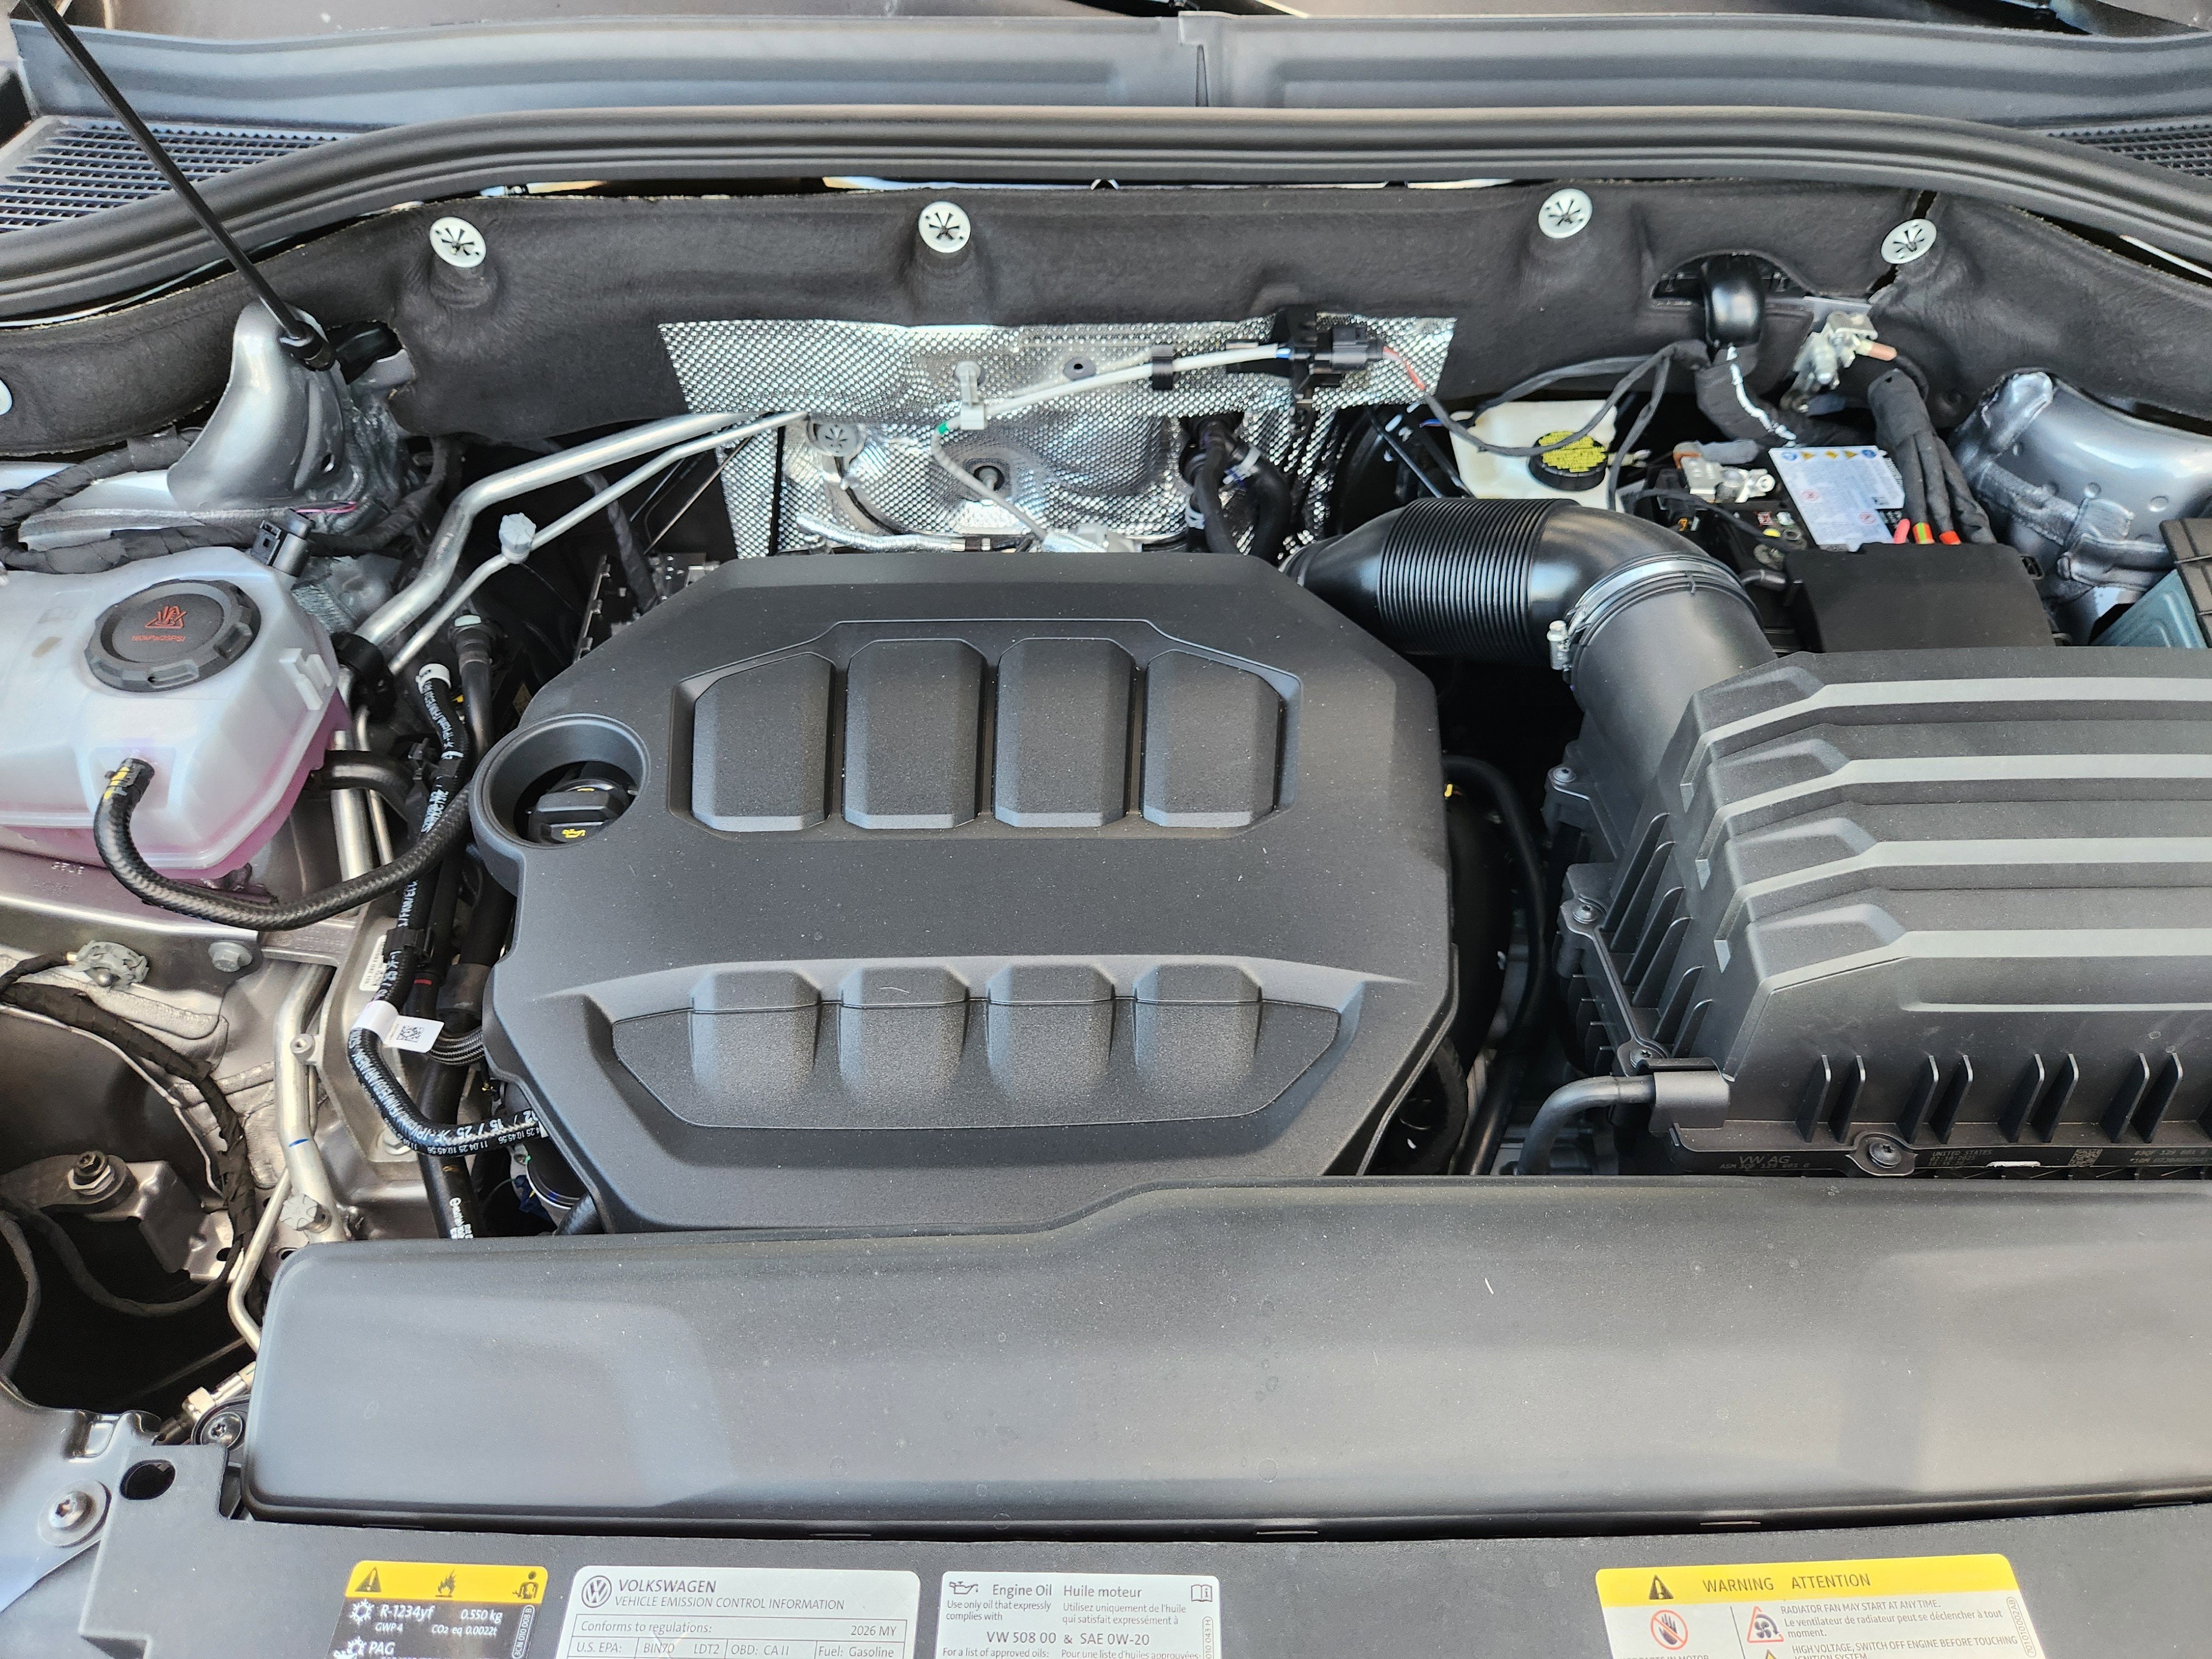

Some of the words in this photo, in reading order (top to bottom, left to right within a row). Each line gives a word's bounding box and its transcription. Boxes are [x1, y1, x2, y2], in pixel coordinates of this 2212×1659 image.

[1769, 1155, 1791, 1164] AG
[619, 1579, 717, 1593] VOLKSWAGEN
[1703, 1577, 1774, 1593] WARNING
[1792, 1573, 1871, 1589] ATTENTION
[993, 1584, 1032, 1599] Engine
[1036, 1584, 1052, 1596] Oil
[1064, 1585, 1094, 1597] Huile
[1098, 1587, 1142, 1598] moteur
[615, 1596, 658, 1606] VEHICLE
[661, 1597, 713, 1608] EMISSION
[716, 1597, 766, 1609] CONTROL
[769, 1599, 845, 1610] INFORMATION
[947, 1600, 962, 1609] Use
[964, 1600, 982, 1611] only
[983, 1600, 993, 1609] oil
[995, 1600, 1012, 1609] that
[1014, 1601, 1052, 1612] expressly
[1063, 1603, 1094, 1612] Utilisez
[1096, 1603, 1147, 1615] uniquement
[1149, 1604, 1159, 1613] de
[1161, 1604, 1186, 1613] l'huile
[1781, 1604, 1823, 1614] RADIATOR
[1825, 1603, 1841, 1612] FAN
[1842, 1603, 1860, 1611] MAY
[1862, 1601, 1886, 1610] START
[1900, 1600, 1916, 1609] ANY
[1917, 1599, 1941, 1609] TIME.
[380, 1604, 435, 1623] R-1234yf
[461, 1609, 488, 1621] 0.550
[489, 1609, 503, 1625] kg
[946, 1611, 982, 1622] complies
[984, 1612, 1003, 1621] with
[1062, 1615, 1076, 1625] qui
[1078, 1615, 1111, 1624] satisfait
[1113, 1615, 1172, 1626] expressément
[1173, 1615, 1179, 1625] à
[1784, 1618, 1795, 1627] Le
[1797, 1616, 1843, 1626] ventilateur
[1845, 1615, 1855, 1625] de
[1856, 1614, 1895, 1624] radiateur
[1897, 1614, 1917, 1624] peut
[1929, 1611, 1975, 1621] déclencher
[1977, 1609, 1983, 1619] à
[1984, 1610, 2003, 1618] tout
[375, 1622, 397, 1632] GWP
[397, 1623, 403, 1632] 4
[452, 1626, 462, 1637] eq
[465, 1625, 498, 1636] 0.0022t
[581, 1620, 632, 1632] Conforms
[635, 1621, 646, 1632] to
[649, 1621, 712, 1635] regulations:
[851, 1625, 876, 1636] 2026
[879, 1626, 897, 1636] MY
[1788, 1629, 1827, 1638] moment.
[514, 1641, 524, 1656] 3CN
[519, 1628, 527, 1640] 010
[523, 1614, 531, 1627] 008
[987, 1631, 1009, 1642] VW
[1013, 1632, 1036, 1644] 508
[1040, 1632, 1057, 1644] 00
[1063, 1634, 1073, 1644] &
[1080, 1633, 1103, 1645] SAE
[1107, 1634, 1150, 1646] 0W-20
[369, 1641, 396, 1656] PAG
[576, 1642, 595, 1652] U.S.
[598, 1642, 622, 1653] EPA:
[643, 1643, 675, 1653] BIN70
[693, 1644, 719, 1654] LDT2
[731, 1644, 758, 1655] OBD:
[764, 1645, 780, 1656] CA
[818, 1646, 843, 1657] Fuel:
[848, 1646, 894, 1658] Gasoline
[1792, 1645, 1814, 1654] HIGH
[1814, 1643, 1854, 1653] VOLTAGE,
[1856, 1641, 1887, 1651] SWITCH
[1889, 1641, 1906, 1650] OFF
[1907, 1639, 1939, 1649] ENGINE
[1939, 1637, 1973, 1648] BEFORE
[1974, 1636, 2018, 1646] TOUCHING
[943, 1647, 956, 1657] For
[966, 1647, 978, 1657] list
[979, 1647, 990, 1657] of
[990, 1648, 1030, 1658] approved
[1032, 1648, 1049, 1657] oils:
[1062, 1649, 1081, 1658] Pour
[1099, 1650, 1116, 1658] liste
[1118, 1650, 1149, 1658] d'huiles
[1151, 1651, 1201, 1659] approuvées:
